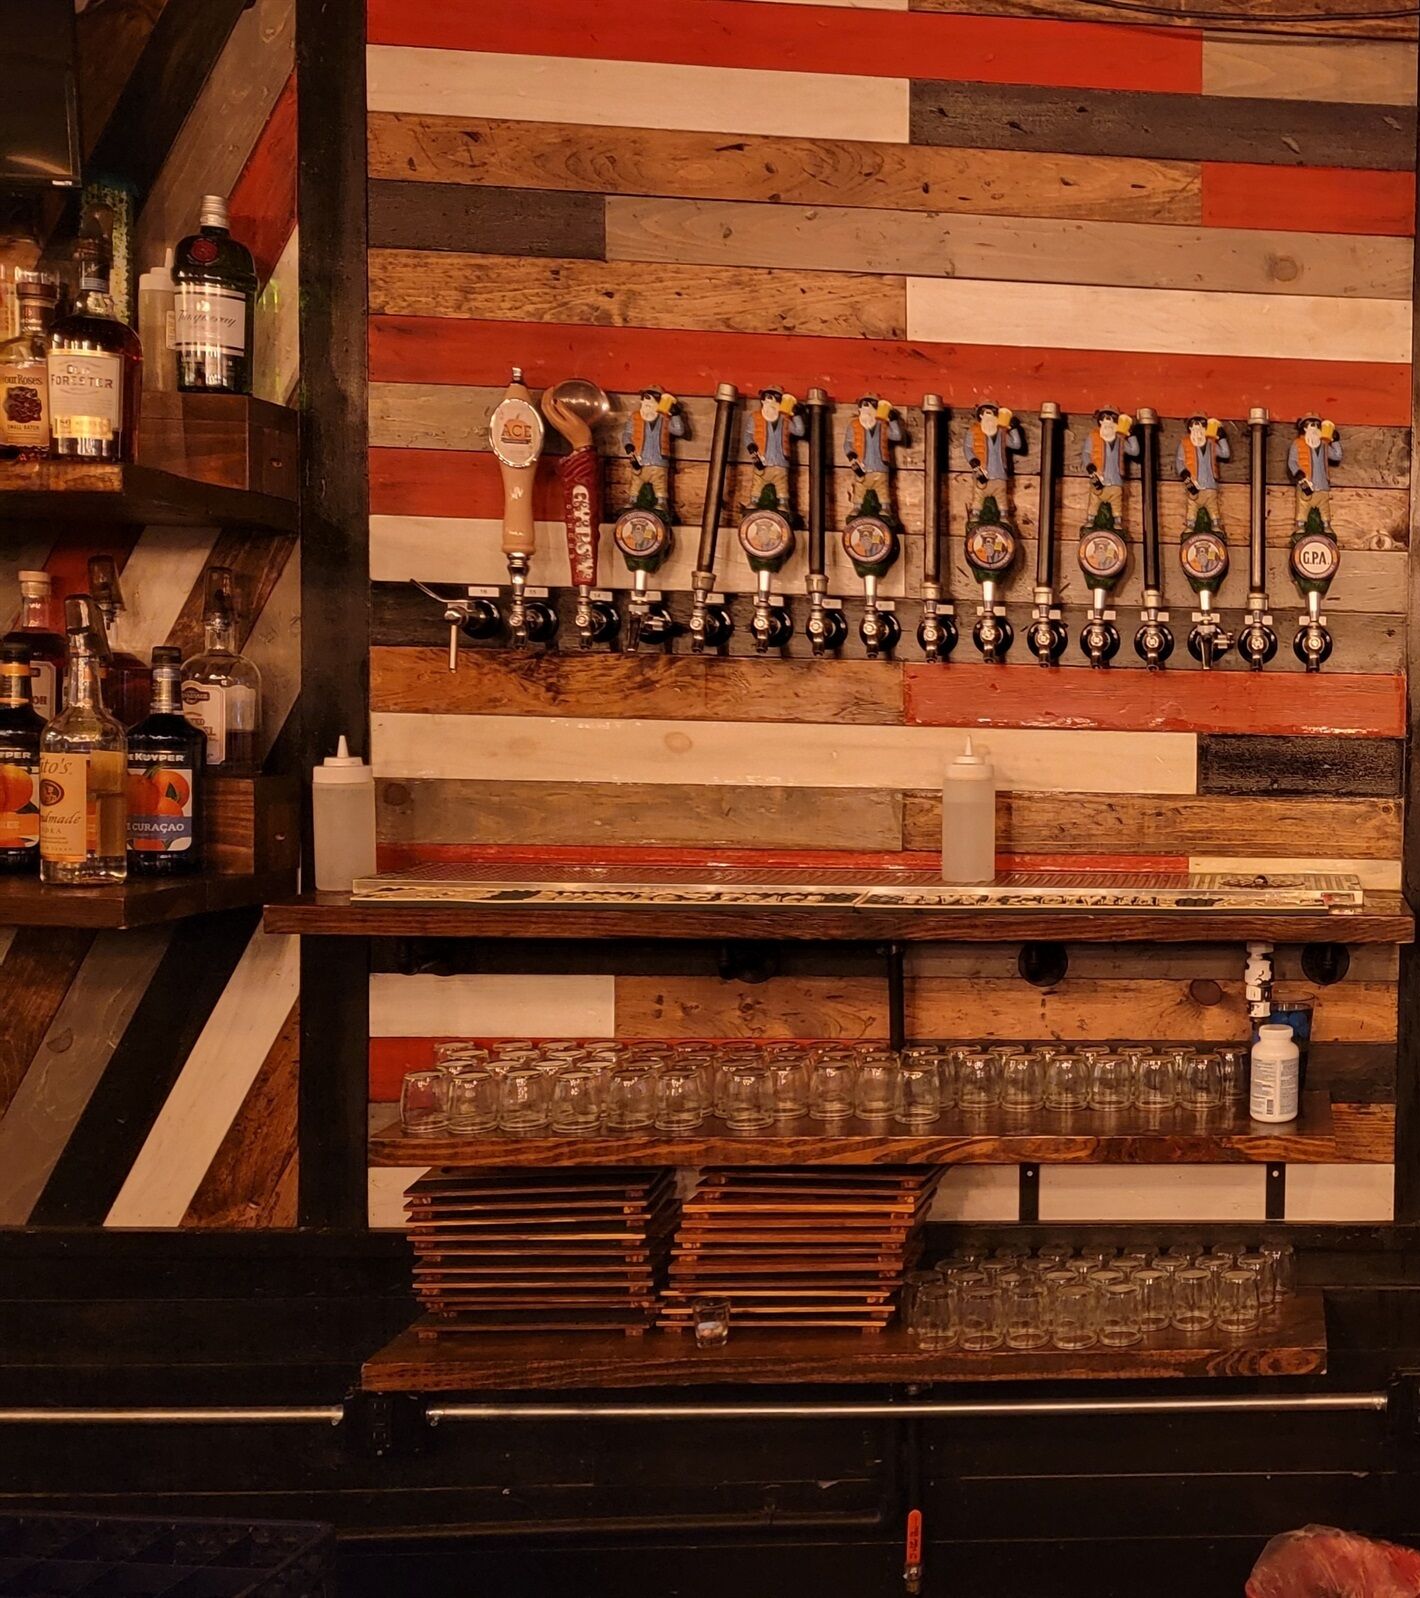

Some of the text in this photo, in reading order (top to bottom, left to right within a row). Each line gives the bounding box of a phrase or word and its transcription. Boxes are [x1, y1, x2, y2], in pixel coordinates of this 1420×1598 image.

[51, 373, 113, 389] FORESTER
[501, 424, 532, 438] ACE
[132, 822, 185, 834] CURAÇAO
